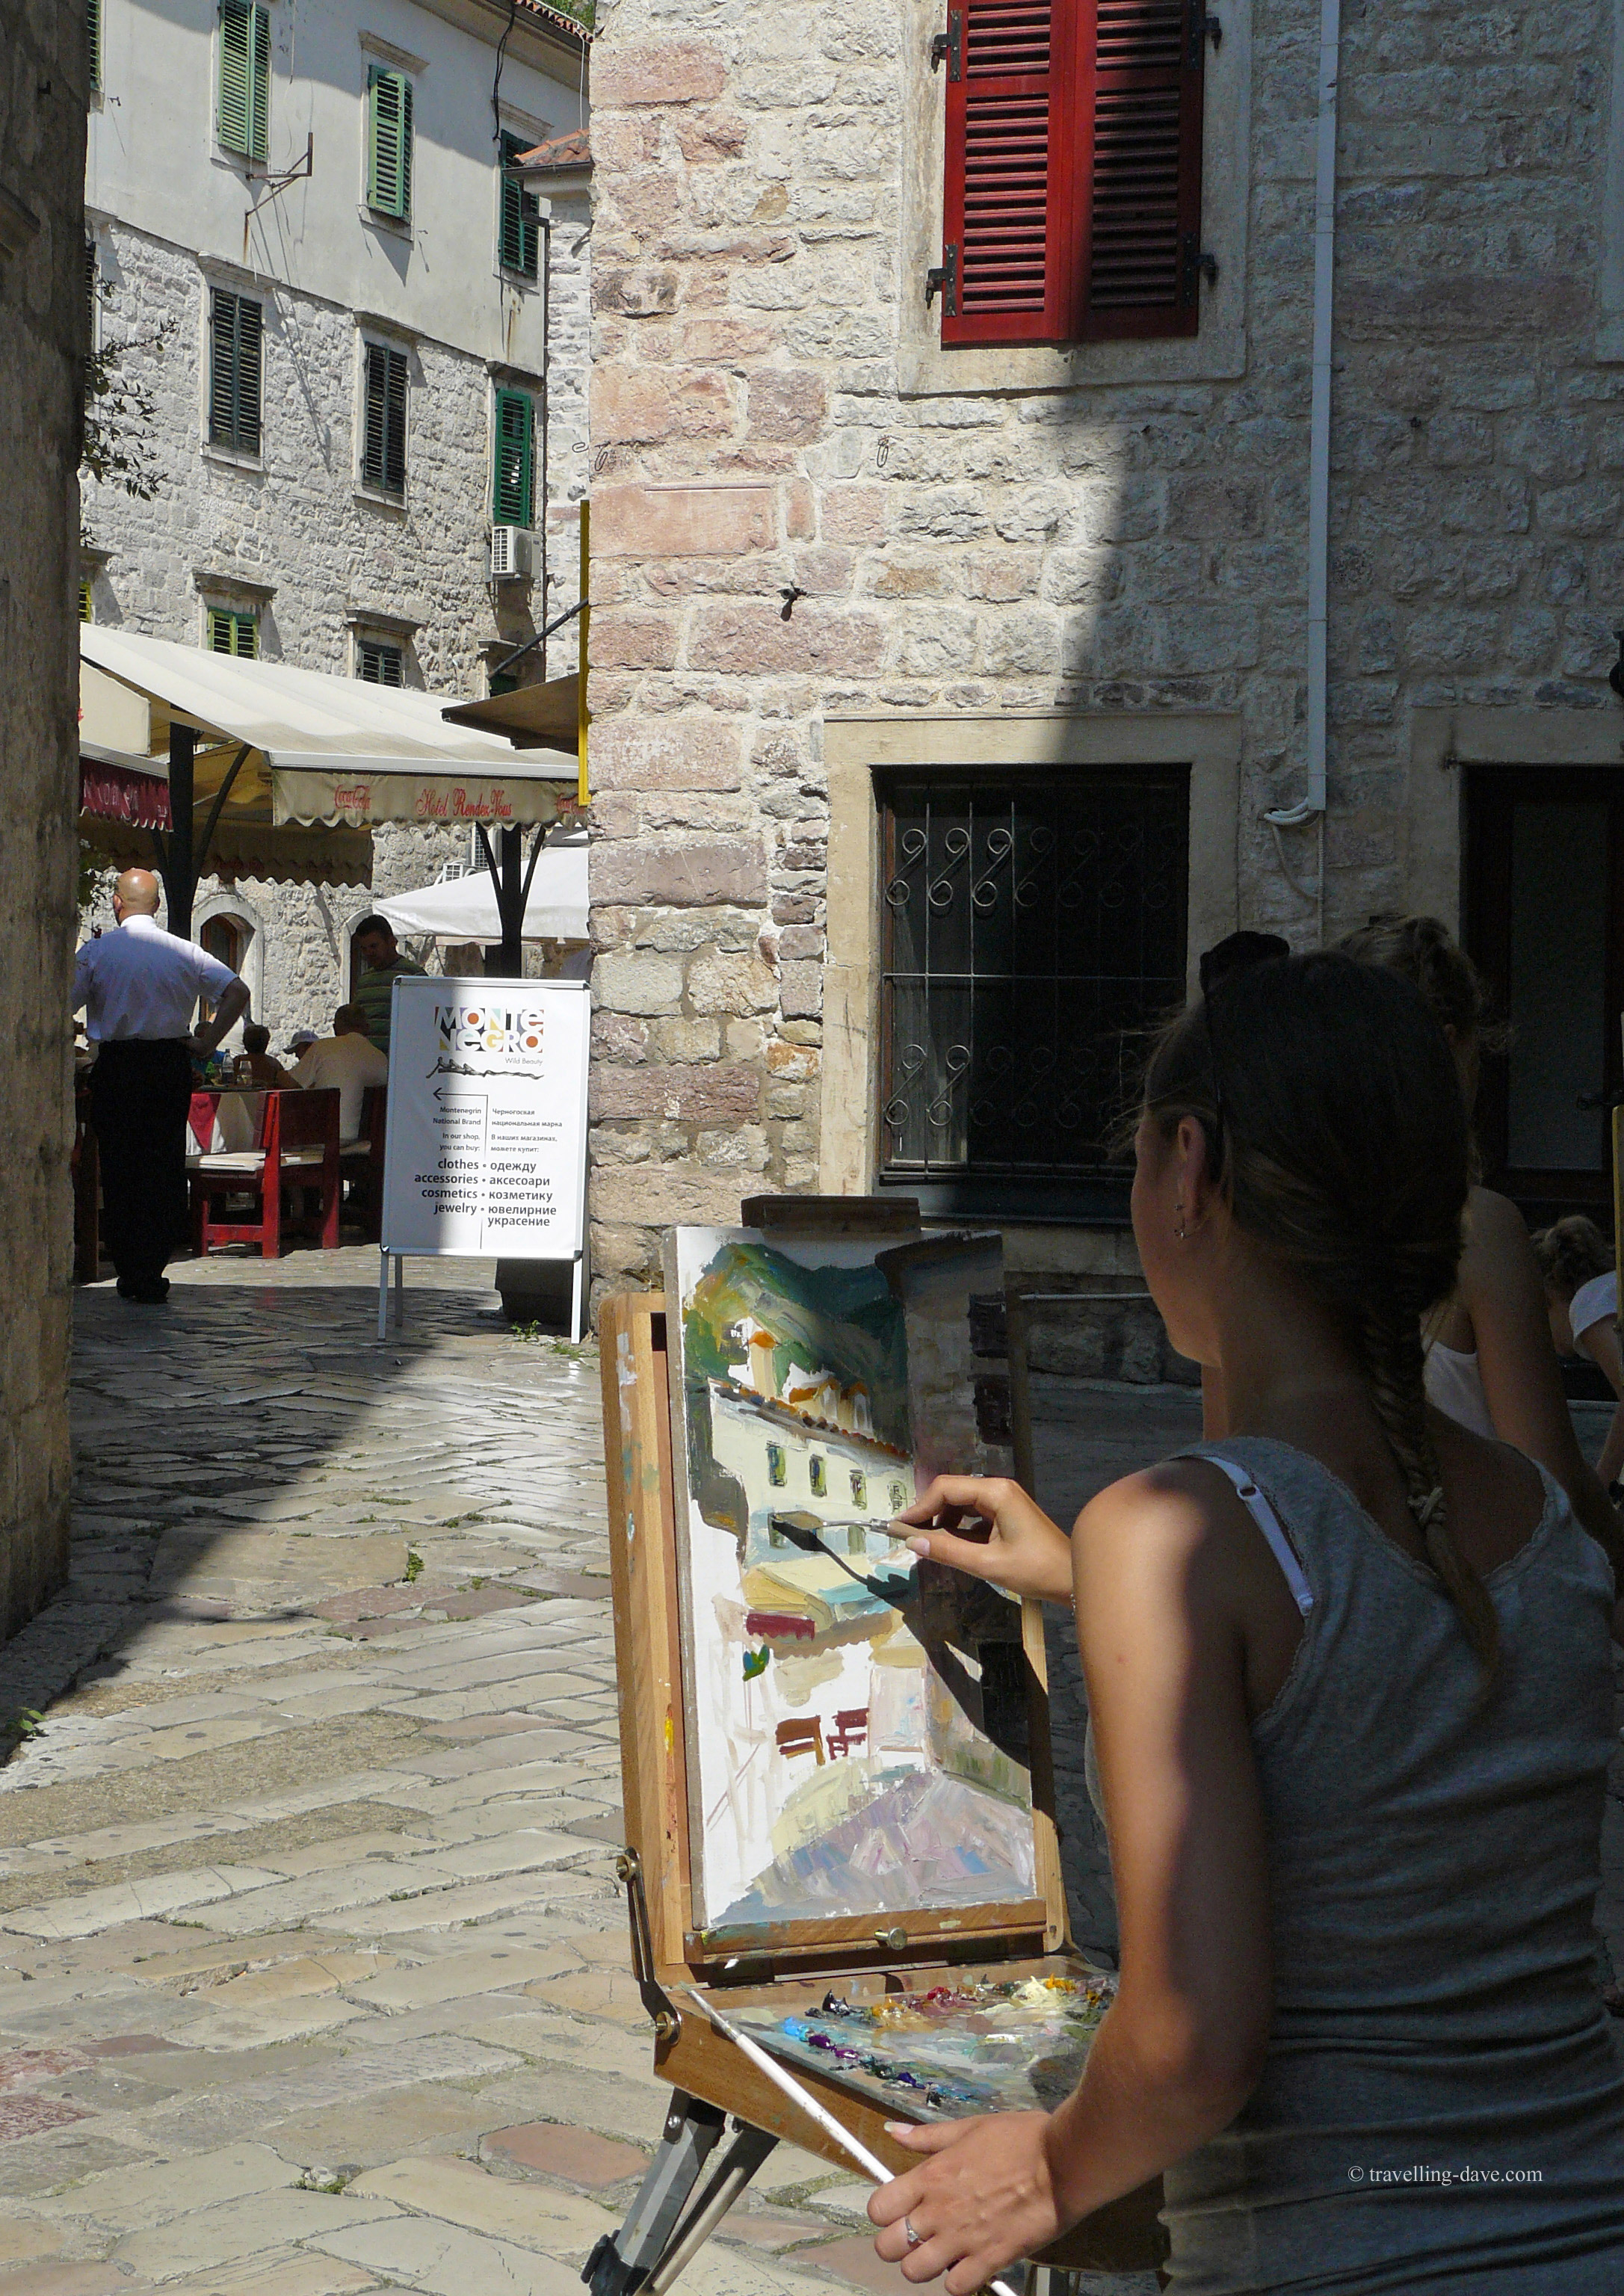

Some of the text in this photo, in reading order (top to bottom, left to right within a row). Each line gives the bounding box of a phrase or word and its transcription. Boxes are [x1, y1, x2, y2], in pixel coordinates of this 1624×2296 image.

[415, 789, 448, 816] Hotel
[504, 1057, 543, 1067] Wild Beauty
[439, 1106, 481, 1116] Montenegrin
[439, 1144, 452, 1152] you
[437, 1158, 479, 1170] clothes
[490, 1161, 537, 1173] одежду
[414, 1173, 479, 1185] accessories
[489, 1176, 550, 1188] аксесоари
[421, 1188, 478, 1199] cosmetics
[489, 1191, 553, 1203] козметику
[433, 1201, 478, 1215] jewelry
[488, 1206, 557, 1217] ювелирние
[487, 1217, 550, 1228] украсение
